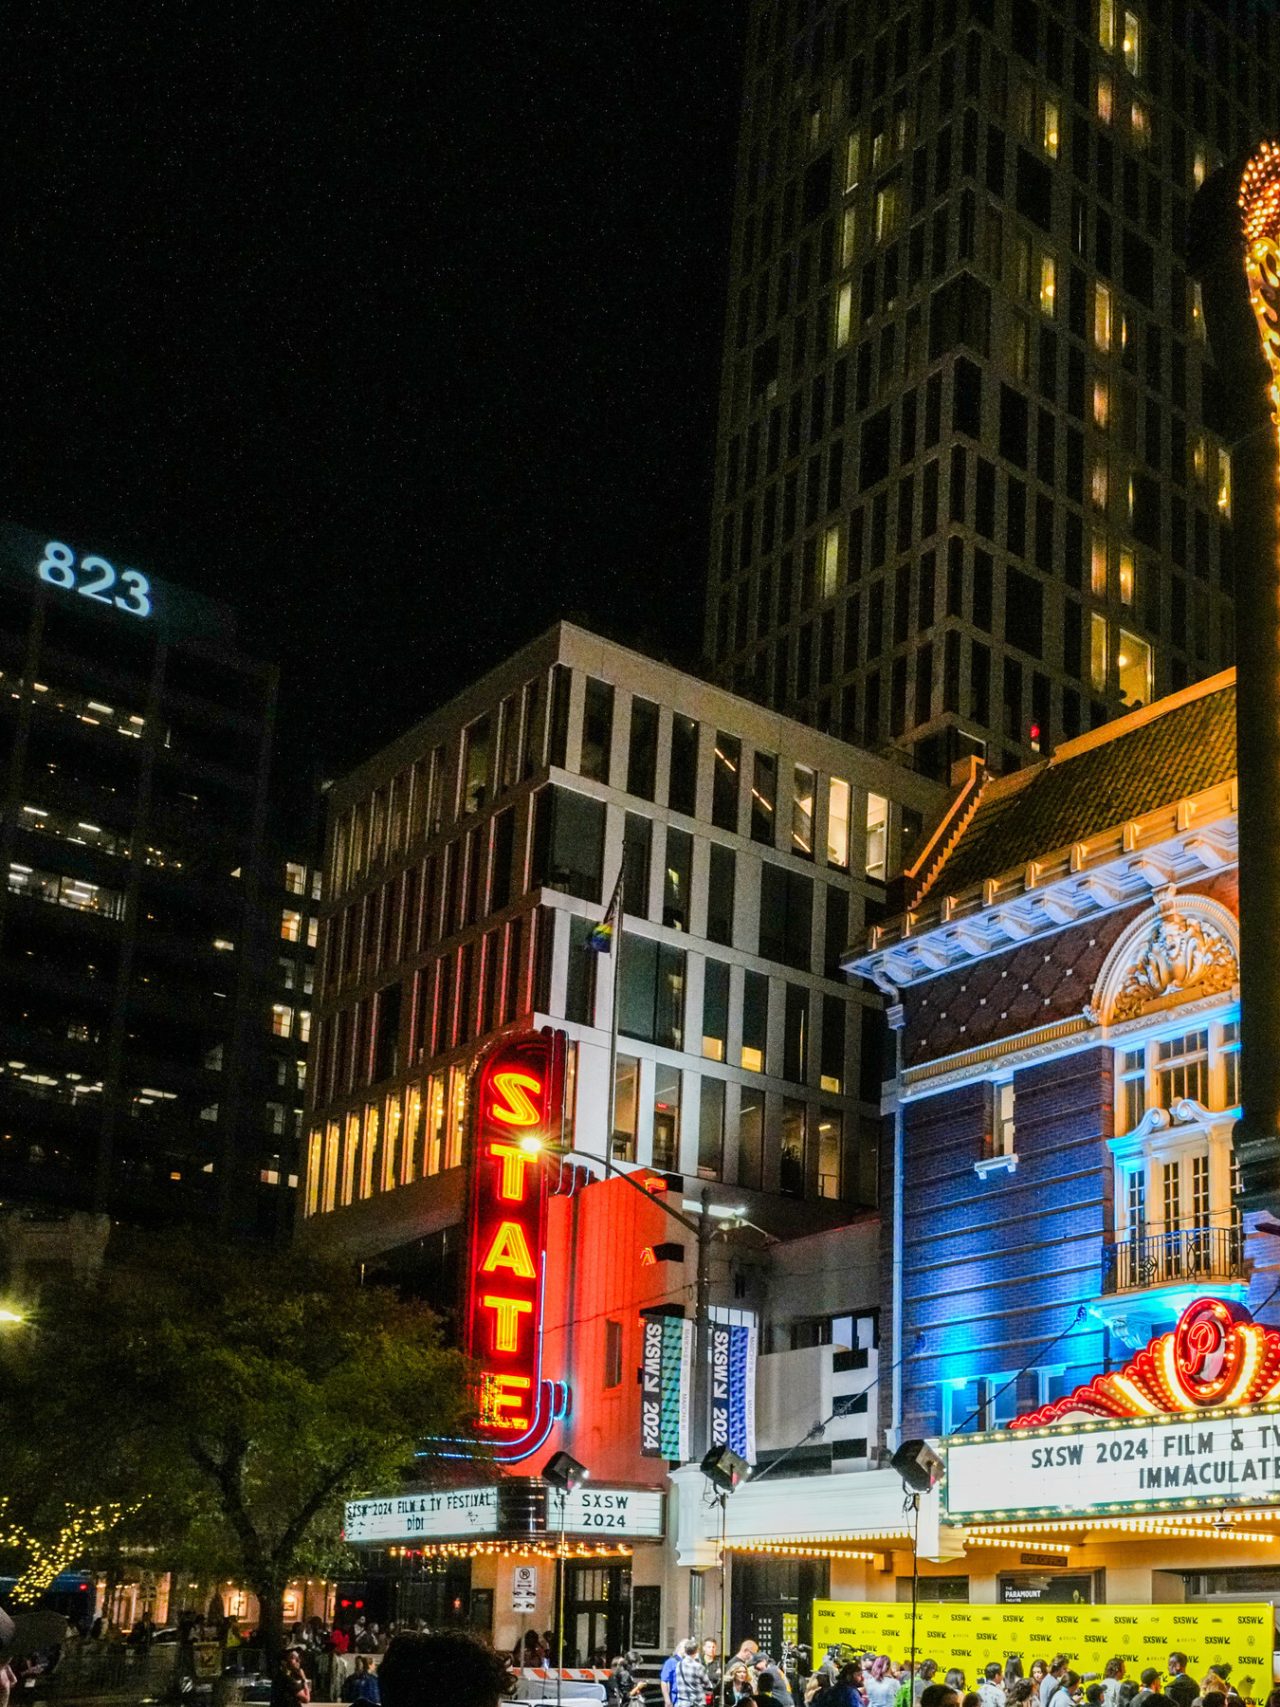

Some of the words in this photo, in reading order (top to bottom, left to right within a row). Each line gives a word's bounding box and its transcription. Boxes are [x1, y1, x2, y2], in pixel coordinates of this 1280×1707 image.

[39, 541, 150, 617] 823
[481, 1072, 541, 1430] STATE
[644, 1323, 662, 1376] SXSW
[713, 1331, 729, 1382] SXSW
[643, 1401, 660, 1449] 2024
[1032, 1444, 1084, 1468] SXSW
[1096, 1438, 1148, 1463] 2024
[1163, 1432, 1213, 1457] FILM
[1230, 1428, 1244, 1451] &
[373, 1502, 392, 1516] 2024
[397, 1500, 415, 1514] FILM
[430, 1497, 442, 1511] TV
[447, 1493, 491, 1510] FESTIVAL
[582, 1494, 628, 1509] SXSW
[583, 1513, 625, 1527] 2024
[1005, 1590, 1041, 1598] PARAMOUNT
[1173, 1616, 1193, 1624] SXSW
[1238, 1616, 1257, 1624] SXSW
[1084, 1635, 1101, 1643] SXSW
[1143, 1636, 1161, 1644] SXSW
[1205, 1636, 1224, 1644] SXSW
[1238, 1656, 1257, 1665] SXSW
